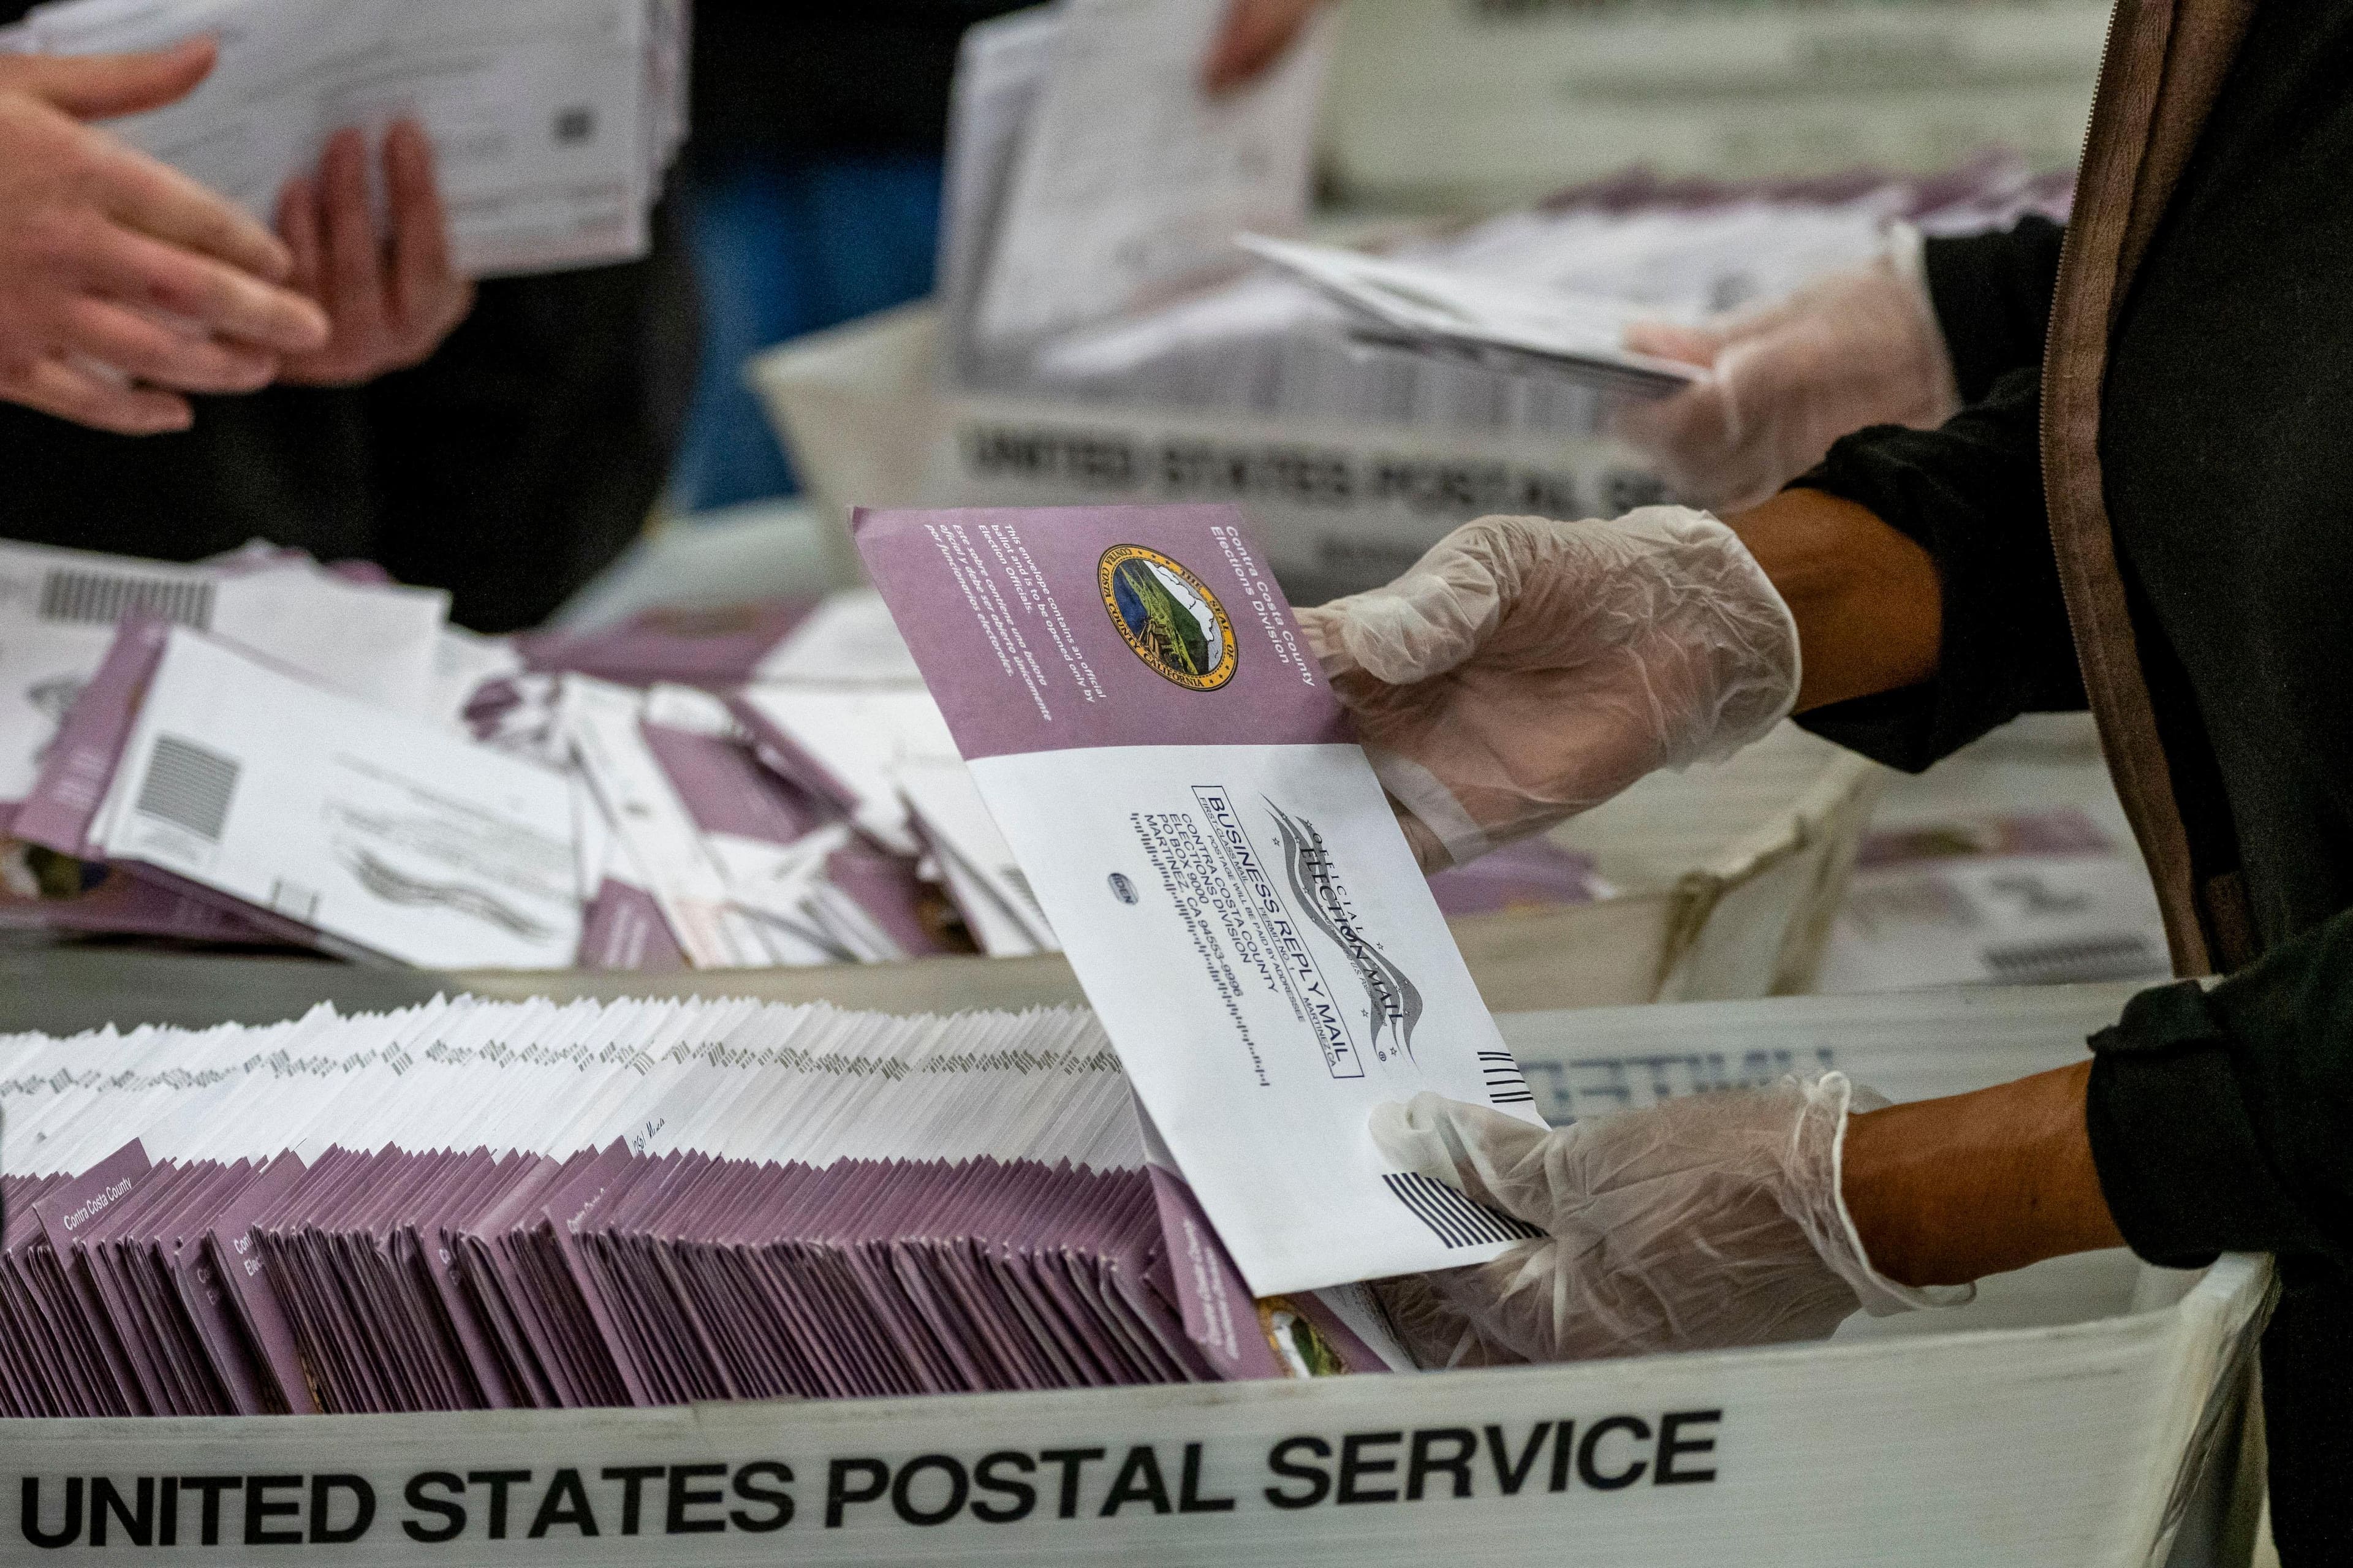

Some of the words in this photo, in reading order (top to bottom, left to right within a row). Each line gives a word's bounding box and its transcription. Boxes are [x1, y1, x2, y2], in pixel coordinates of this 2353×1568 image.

[924, 525, 942, 542] por
[936, 543, 980, 610] funcionarios
[977, 613, 1013, 676] electorales.
[940, 525, 965, 555] oficial
[965, 566, 983, 593] debe
[980, 595, 994, 612] ser
[991, 614, 1016, 653] abierto
[953, 525, 969, 545] Este
[967, 548, 988, 576] sobre
[985, 579, 1014, 624] contiene
[1011, 627, 1026, 648] una
[979, 525, 1007, 564] Election
[1006, 567, 1031, 613] Officials.
[991, 525, 1014, 553] ballot
[1011, 556, 1028, 575] and
[1031, 589, 1040, 600] to
[1037, 604, 1048, 617] be
[1046, 620, 1073, 661] opened
[1069, 664, 1086, 686] only
[1084, 690, 1094, 702] by
[1005, 525, 1020, 544] This
[1018, 547, 1049, 594] envelope
[1048, 597, 1074, 643] contains
[1072, 646, 1082, 659] an
[1081, 662, 1106, 697] official
[1101, 567, 1111, 597] COSTA
[1105, 548, 1131, 565] CONTRA
[1181, 569, 1202, 589] THE
[1210, 600, 1229, 632] SEAL
[1224, 645, 1233, 659] OF
[1211, 526, 1254, 595] Elections
[1252, 601, 1289, 663] Division
[1226, 526, 1257, 576] Contra
[1257, 581, 1284, 625] Costa
[1283, 631, 1314, 686] County
[1109, 603, 1140, 649] COUNTY
[1143, 654, 1204, 687] CALIFORNIA
[1145, 815, 1189, 892] MARTINEZ,
[1187, 897, 1202, 917] CA
[1198, 920, 1243, 996] 94553-9996
[1157, 814, 1173, 835] PO
[1170, 838, 1191, 868] BOX
[1187, 873, 1209, 904] 9000
[1169, 814, 1217, 895] ELECTIONS
[1213, 900, 1251, 963] DIVISION
[1181, 814, 1217, 874] CONTRA
[1214, 877, 1244, 927] COSTA
[1241, 931, 1278, 992] COUNTY
[1207, 835, 1234, 879] POSTAGE
[1233, 883, 1246, 903] WILL
[1245, 907, 1254, 917] BE
[1252, 922, 1268, 945] PAID
[1265, 948, 1275, 960] BY
[1273, 963, 1304, 1021] ADDRESSEE
[1310, 832, 1364, 934] OFFICIAL
[1200, 797, 1236, 859] FIRST-CLASS
[1234, 862, 1248, 884] MAIL
[1259, 907, 1281, 942] PERMIT
[1276, 946, 1289, 960] NO.
[1302, 998, 1330, 1049] MARTINEZ
[1325, 1052, 1336, 1066] CA
[1208, 798, 1279, 912] BUSINESS
[1275, 921, 1324, 996] REPLY
[1316, 1005, 1347, 1061] MAIL
[1298, 847, 1370, 960] ELECTION
[1363, 968, 1403, 1025] MAIL
[64, 1208, 89, 1230] Contra
[86, 1193, 108, 1215] Costa
[106, 1177, 132, 1201] County
[21, 1474, 376, 1548] UNITED
[401, 1461, 795, 1543] STATES
[824, 1443, 1235, 1528] POSTAL
[1264, 1409, 1723, 1510] SERVICE
